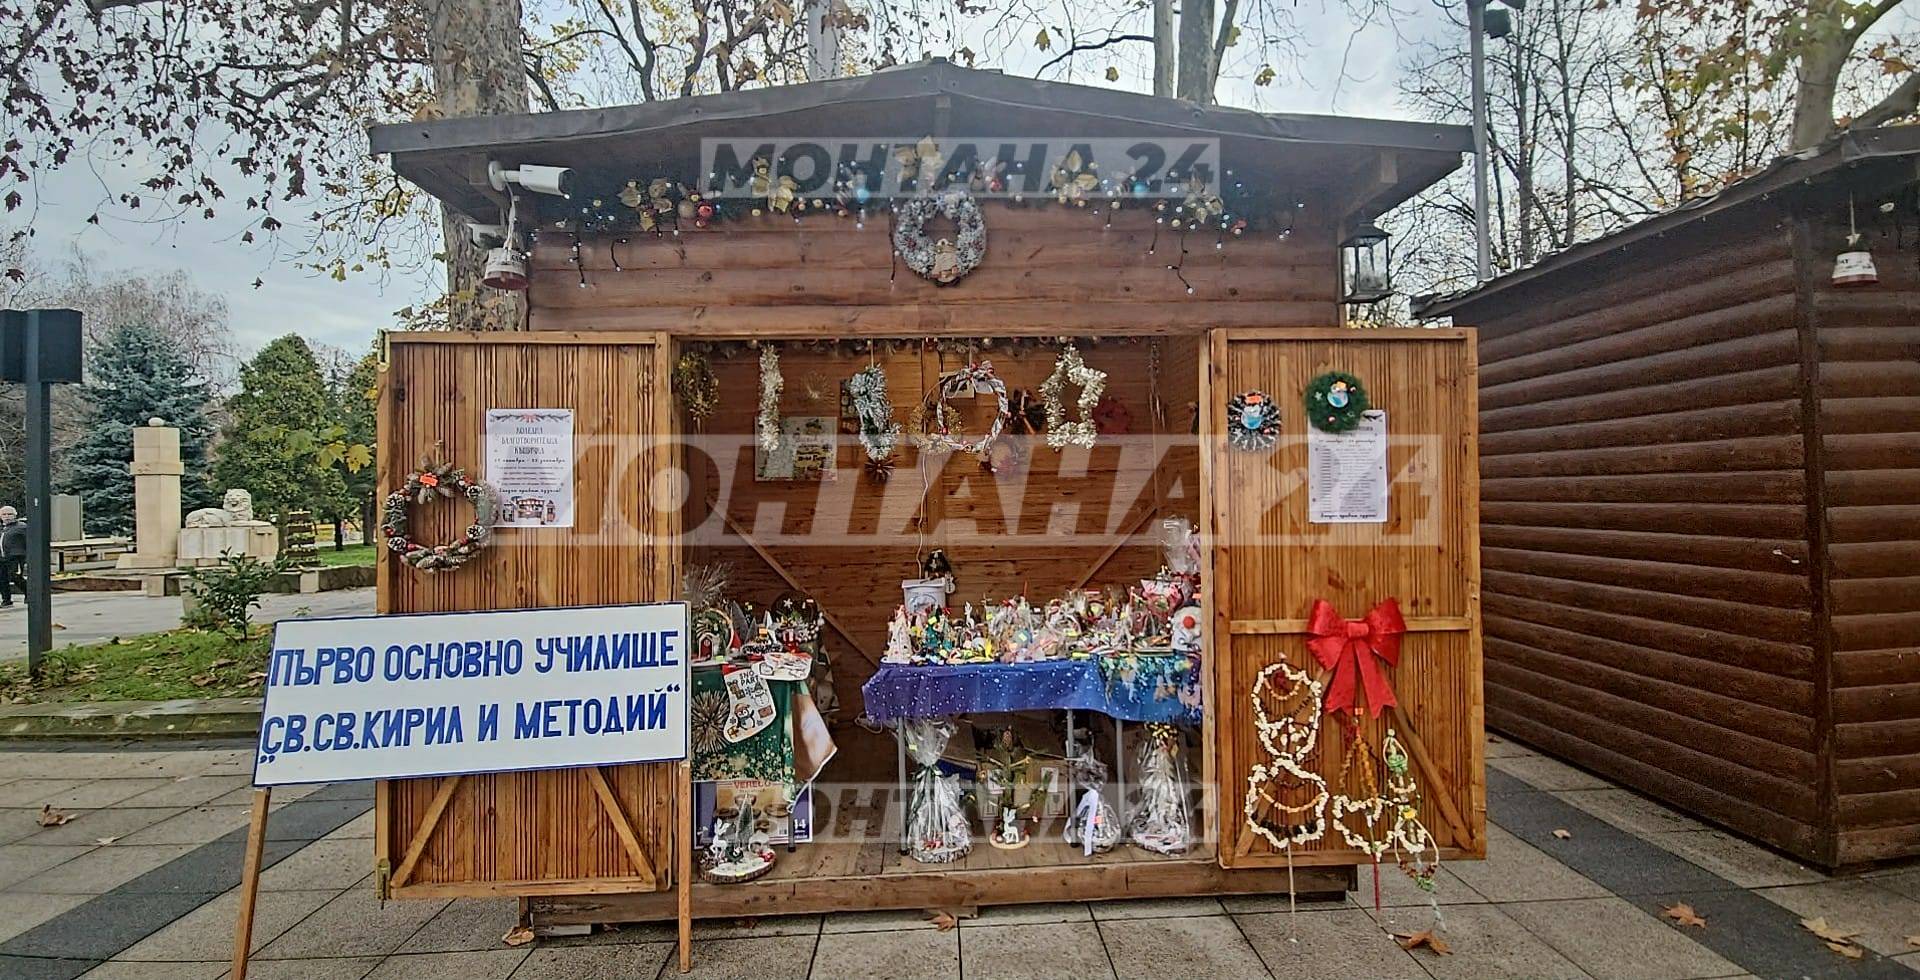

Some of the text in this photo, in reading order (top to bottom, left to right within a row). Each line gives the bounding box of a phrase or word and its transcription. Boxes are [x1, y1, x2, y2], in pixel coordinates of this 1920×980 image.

[270, 629, 680, 687] ПЪРВО ОСНОВНО УЧИЛИЩЕ
[476, 703, 499, 742] И
[793, 818, 807, 830] 14
